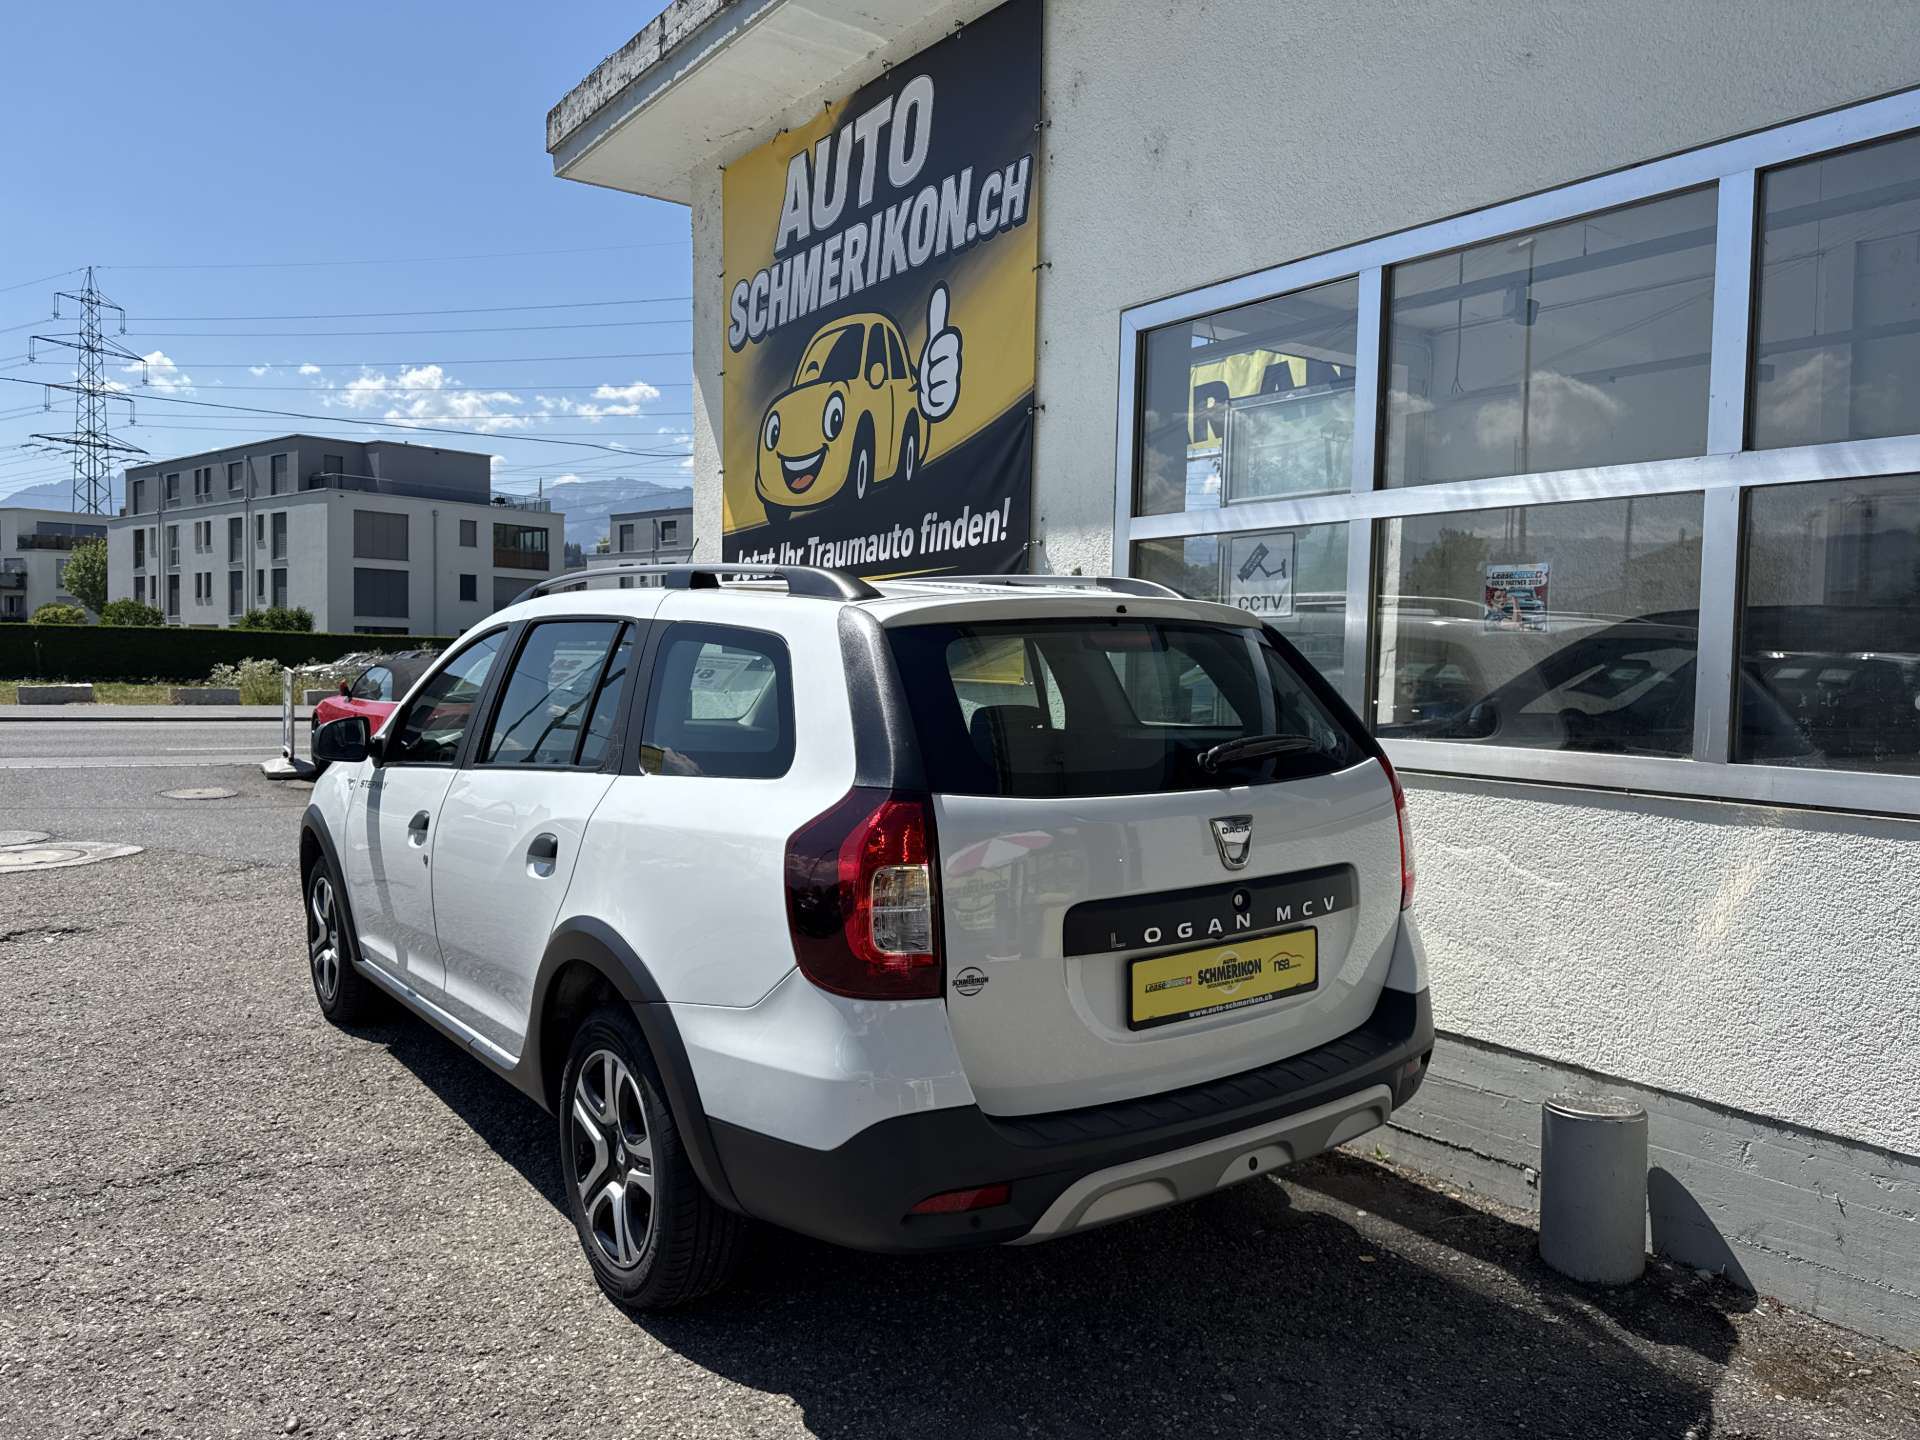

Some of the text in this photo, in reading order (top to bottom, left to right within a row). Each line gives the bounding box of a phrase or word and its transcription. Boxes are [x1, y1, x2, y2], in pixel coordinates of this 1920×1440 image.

[775, 74, 934, 253] AUTO
[729, 156, 1032, 349] SCHMERIKON.CH
[779, 541, 805, 566] Ihr
[808, 523, 915, 569] Traumauto
[920, 497, 1011, 555] finden!
[1238, 595, 1283, 611] CCTV
[1221, 824, 1250, 835] DACIA
[1110, 896, 1335, 949] LOGAN MCV
[1197, 958, 1262, 986] SCHMERIKON
[1273, 958, 1290, 973] nsa
